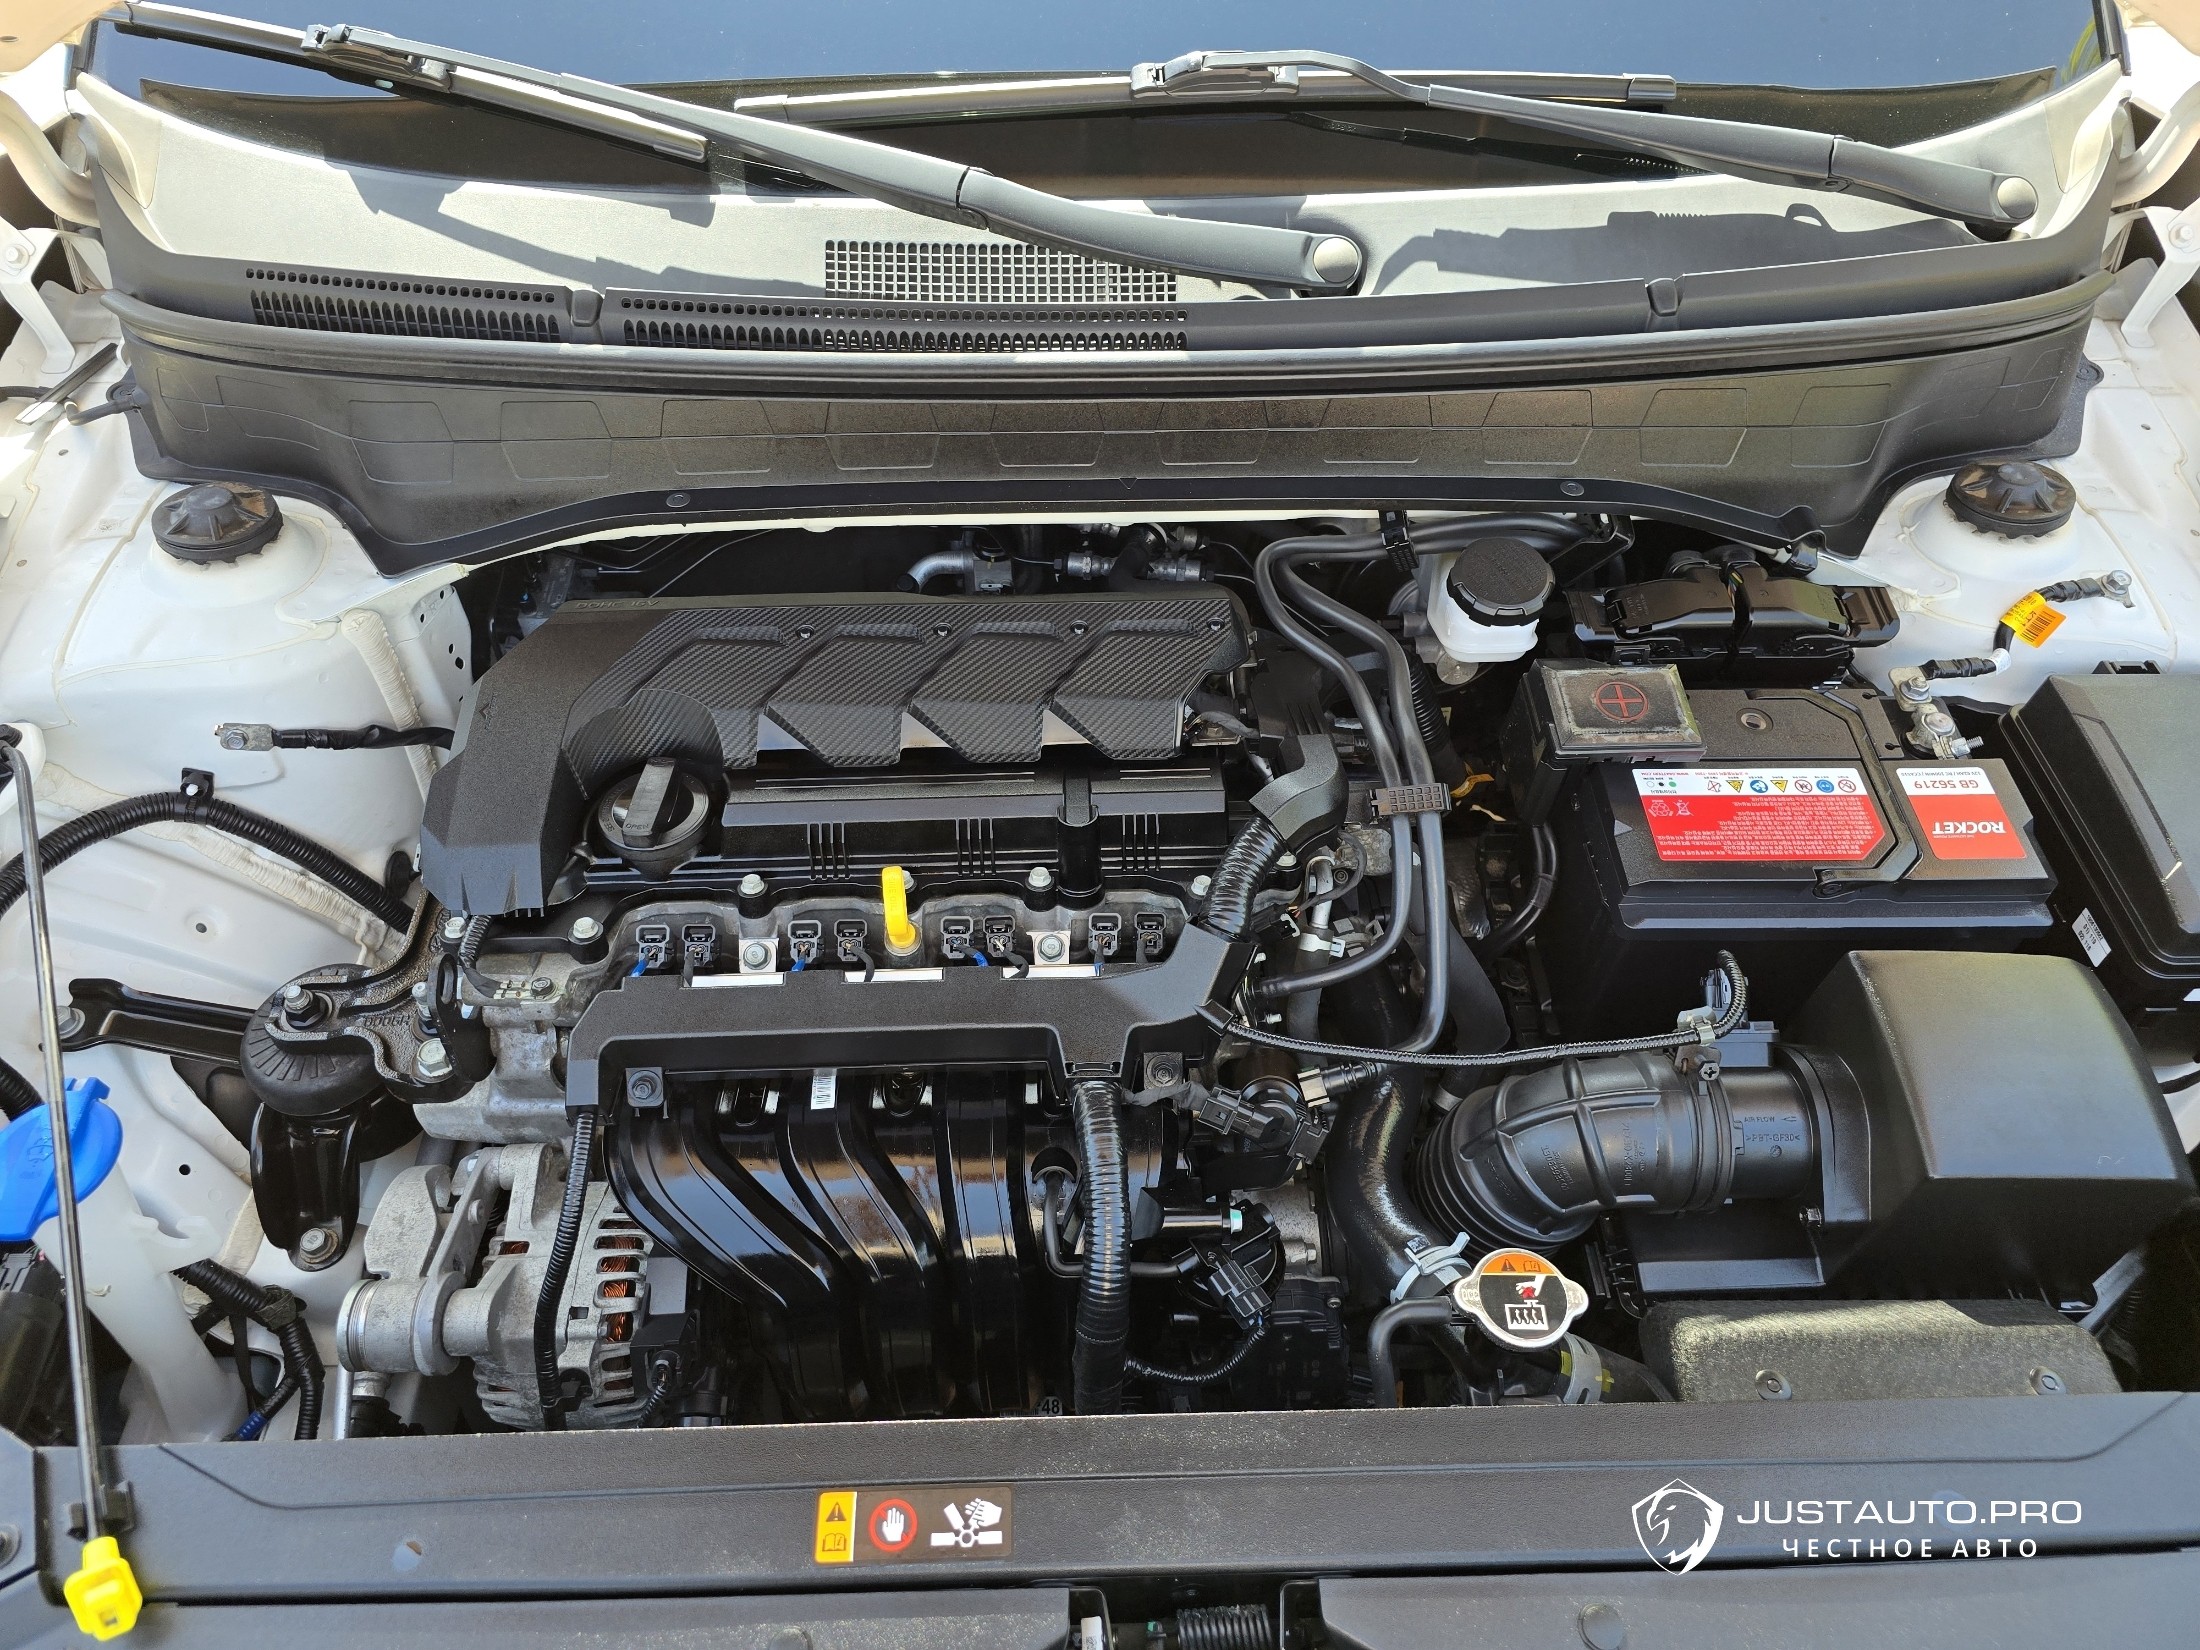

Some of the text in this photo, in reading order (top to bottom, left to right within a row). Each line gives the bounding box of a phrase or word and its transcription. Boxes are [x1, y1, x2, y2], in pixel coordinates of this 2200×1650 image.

[575, 600, 660, 610] DOHC 16V
[1914, 779, 1979, 789] GB 56219
[1932, 821, 2007, 834] ROCKET
